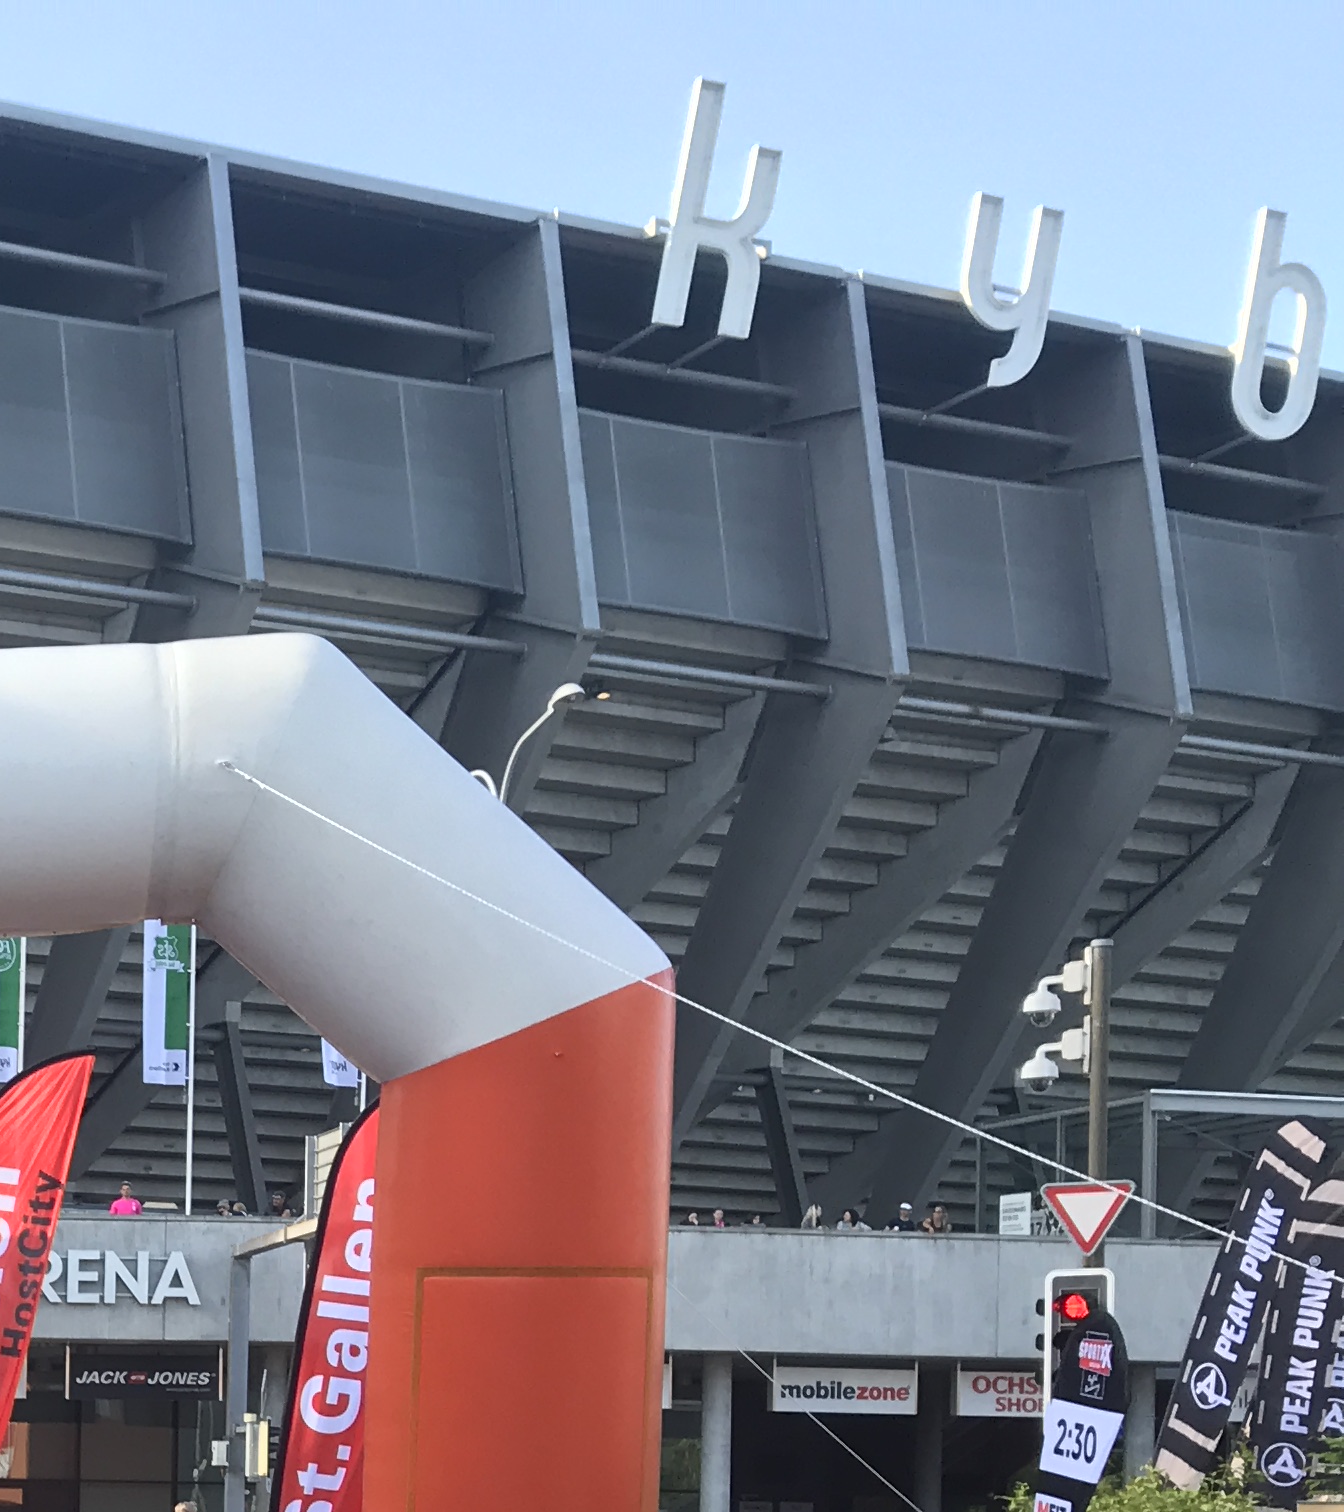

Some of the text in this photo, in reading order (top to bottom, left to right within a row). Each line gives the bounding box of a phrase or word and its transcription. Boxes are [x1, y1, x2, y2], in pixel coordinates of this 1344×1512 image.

[0, 1170, 64, 1358] HostCity
[41, 1249, 202, 1306] RENA
[1214, 1281, 1258, 1362] PEAK
[75, 1370, 128, 1385] JACK
[780, 1381, 910, 1401] mobilezone
[971, 1375, 1043, 1395] OCHS
[1280, 1356, 1318, 1434] PEAK
[1053, 1417, 1098, 1465] 2:30
